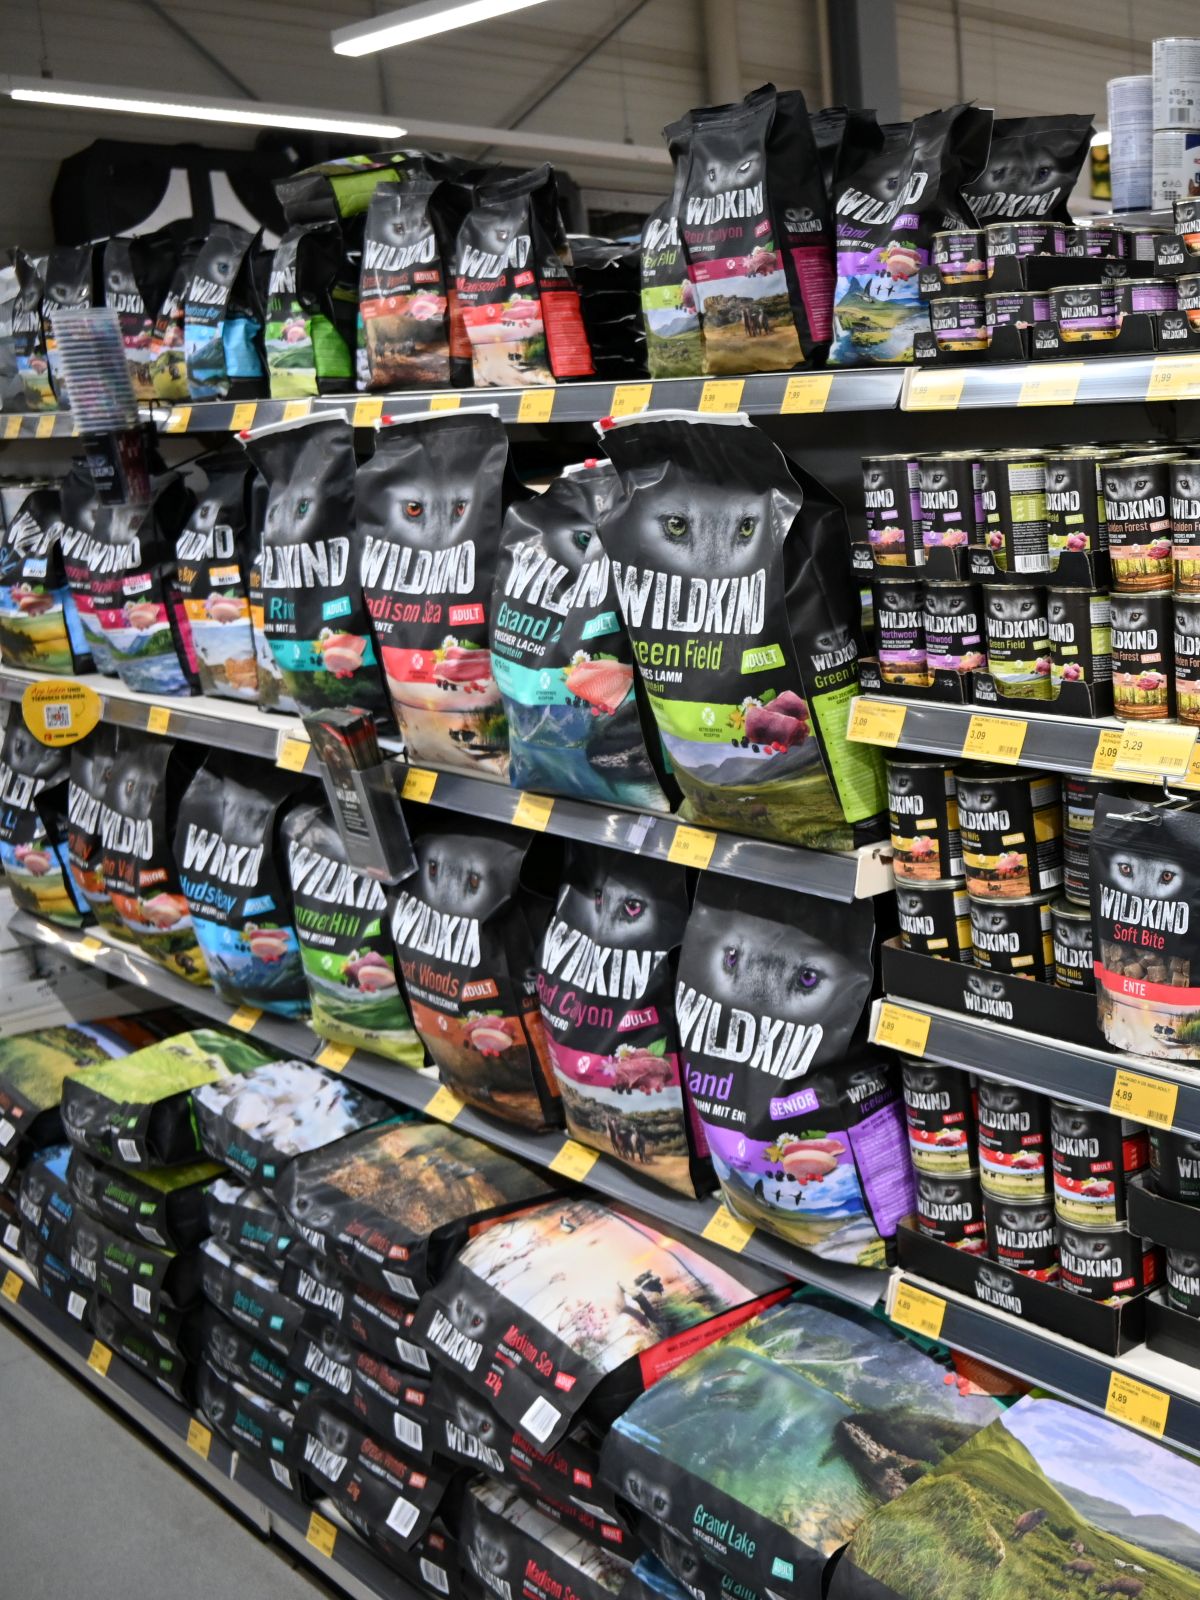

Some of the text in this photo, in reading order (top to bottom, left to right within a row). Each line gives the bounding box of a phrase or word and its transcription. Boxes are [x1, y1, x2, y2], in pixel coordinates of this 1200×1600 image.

[784, 219, 822, 233] WILDKIND
[1060, 307, 1098, 319] WILDKIND
[1174, 522, 1194, 531] Golden
[360, 536, 476, 595] WILDKIND
[613, 560, 766, 636] WILDKIND
[421, 600, 441, 623] Sea
[452, 606, 481, 622] ADULT
[498, 602, 546, 641] Grand
[987, 618, 1048, 639] WILDKIND
[685, 640, 723, 670] Field
[989, 639, 1025, 649] Green Field
[655, 671, 682, 683] LAMM
[814, 670, 849, 689] Green
[970, 730, 986, 740] 3,09
[1123, 740, 1143, 752] 3,29
[1099, 884, 1189, 936] WILDKIND
[329, 913, 359, 938] Hill
[1113, 924, 1165, 950] Soft Bite
[419, 966, 459, 997] Woods
[463, 982, 492, 999] ADULT
[1123, 980, 1146, 996] ENTE
[771, 1091, 816, 1117] SENIOR
[1115, 1089, 1133, 1102] 4,89
[713, 1104, 730, 1120] MIT
[1061, 1249, 1122, 1278] WILDKIND
[426, 1310, 483, 1372] WILDKIND
[503, 1324, 553, 1377] Madison Sea
[693, 1504, 756, 1559] Grand Lake
